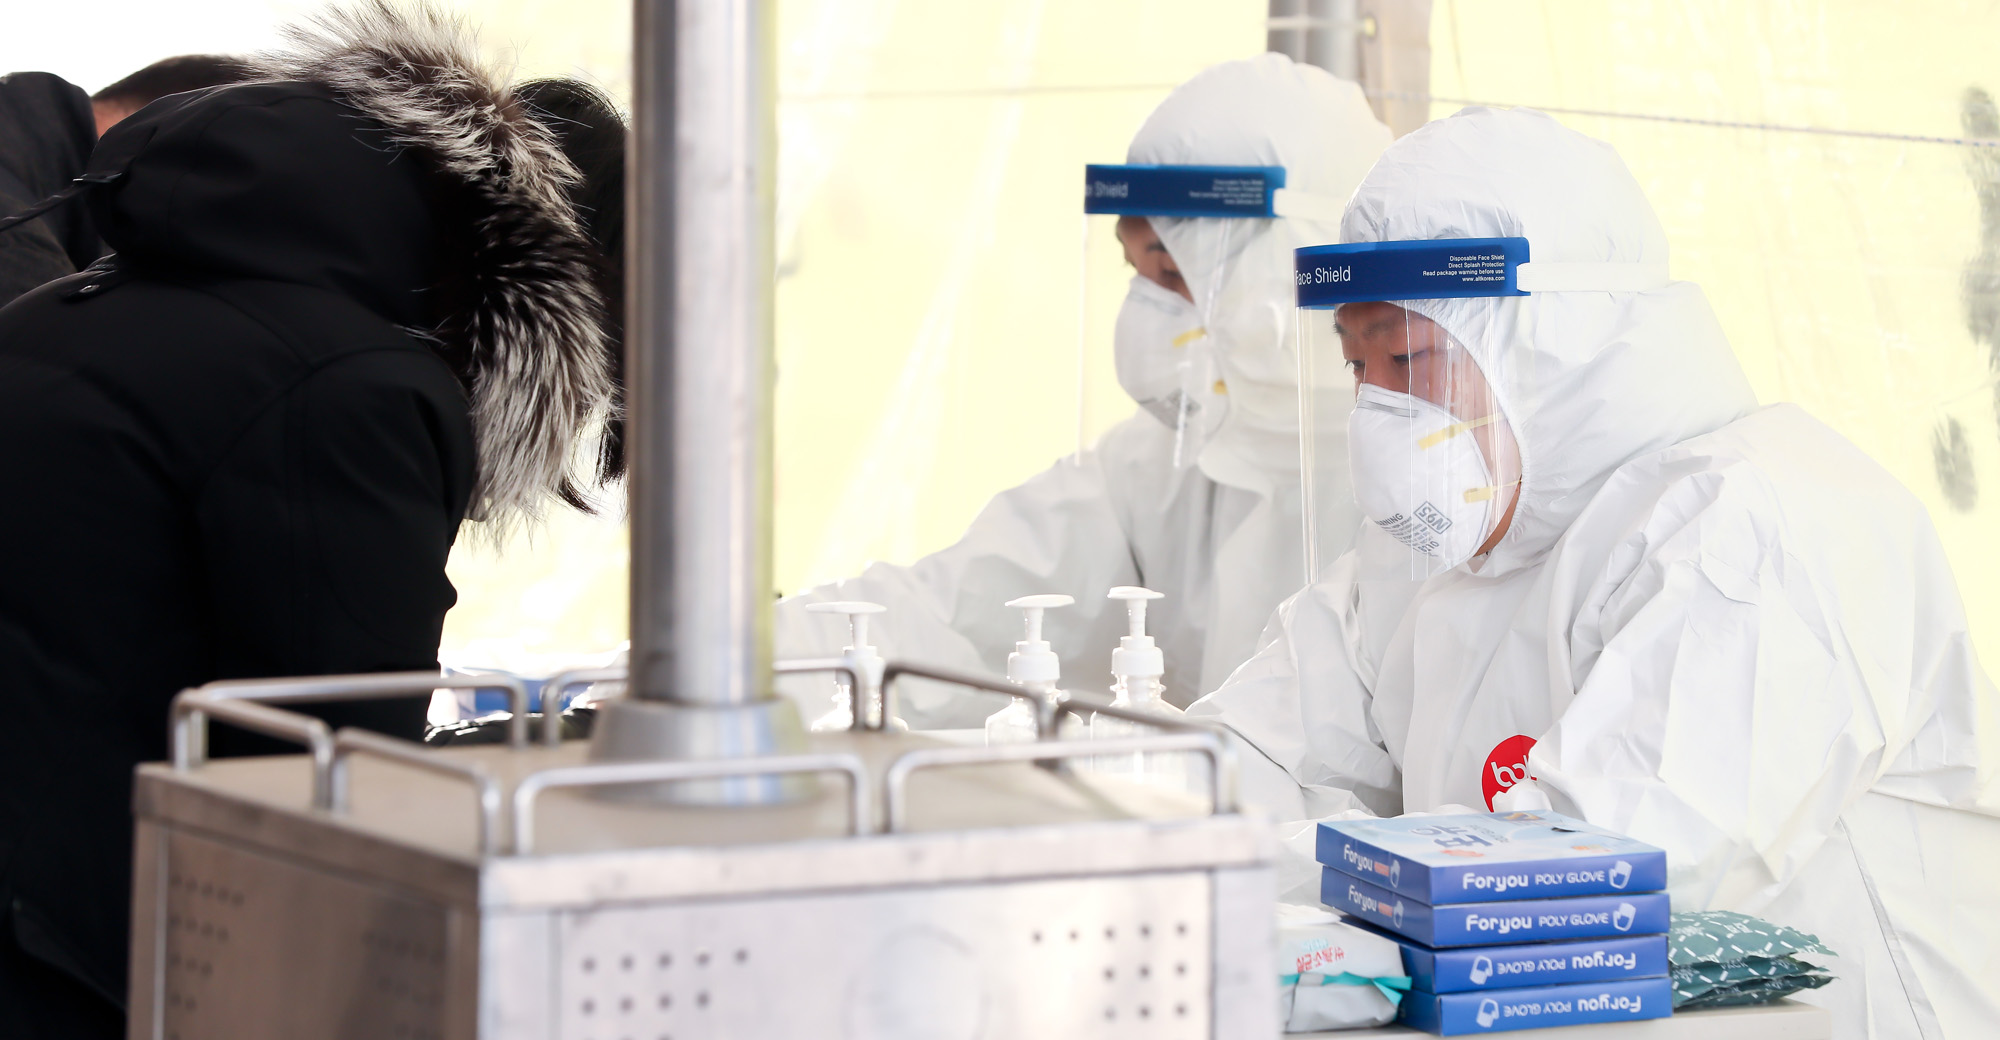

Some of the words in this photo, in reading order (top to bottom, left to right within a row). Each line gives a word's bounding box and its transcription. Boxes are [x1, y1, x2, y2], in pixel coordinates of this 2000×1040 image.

[1315, 265, 1351, 284] Shield
[1418, 506, 1449, 531] N95
[1343, 843, 1373, 872] Foryou
[1462, 872, 1529, 892] Foryou
[1534, 872, 1565, 886] POLY
[1566, 870, 1605, 884] GLOVE
[1348, 884, 1377, 912] Foryou
[1465, 914, 1532, 934] Foryou
[1538, 914, 1568, 928] POLY
[1569, 912, 1609, 926] GLOVE
[1496, 960, 1536, 975] GLOVE
[1537, 958, 1566, 971] POLY
[1571, 950, 1637, 970] Foryou
[1503, 1003, 1542, 1018] GLOVE
[1543, 1001, 1572, 1014] POLY
[1577, 994, 1642, 1013] Foryou
